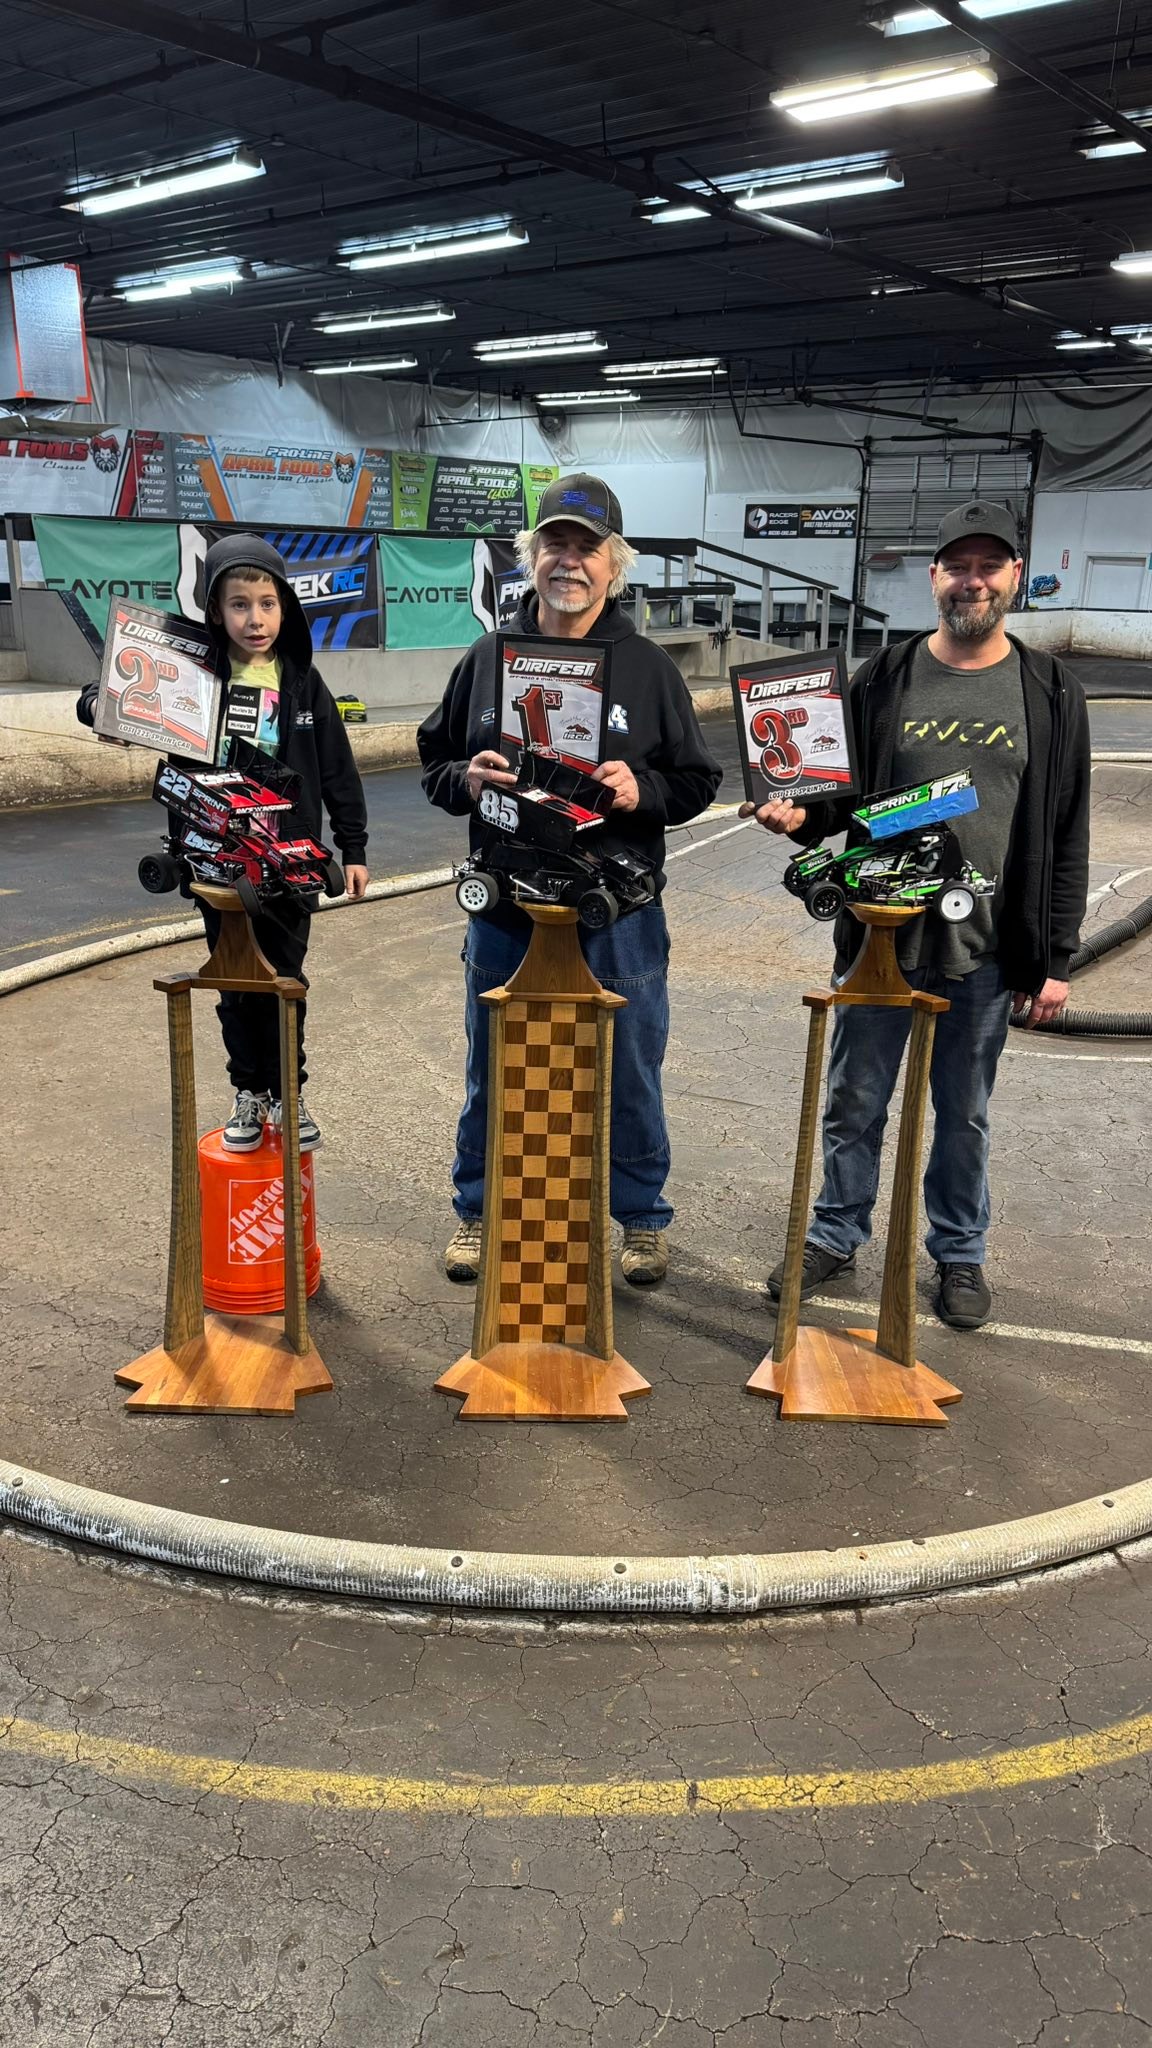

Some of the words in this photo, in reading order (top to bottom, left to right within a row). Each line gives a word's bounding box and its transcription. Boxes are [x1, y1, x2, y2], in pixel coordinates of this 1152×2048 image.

[16, 440, 89, 461] FOOLS
[43, 461, 86, 470] Classic
[222, 453, 275, 473] APRIL
[279, 457, 333, 477] FOOLS
[437, 474, 474, 486] APRIL
[476, 477, 517, 489] FOOLS
[487, 487, 518, 499] CLASSIC
[333, 567, 366, 593] RC
[386, 586, 468, 603] CAYOTE
[499, 580, 528, 605] PR
[124, 621, 210, 657] DIRTFEST
[512, 657, 597, 677] DIRTFEST
[750, 671, 832, 700] DIRTFEST
[150, 732, 176, 746] SPRINT
[176, 740, 192, 751] CAR
[904, 720, 1014, 748] RVCA
[750, 708, 810, 788] 3RD
[798, 784, 823, 795] SPRINT
[823, 781, 837, 791] CAR
[192, 788, 228, 812] SPRINT
[478, 790, 519, 828] 85
[870, 791, 921, 813] SPRINT
[279, 845, 312, 854] SPRINT
[230, 1178, 284, 1233] DEPOT
